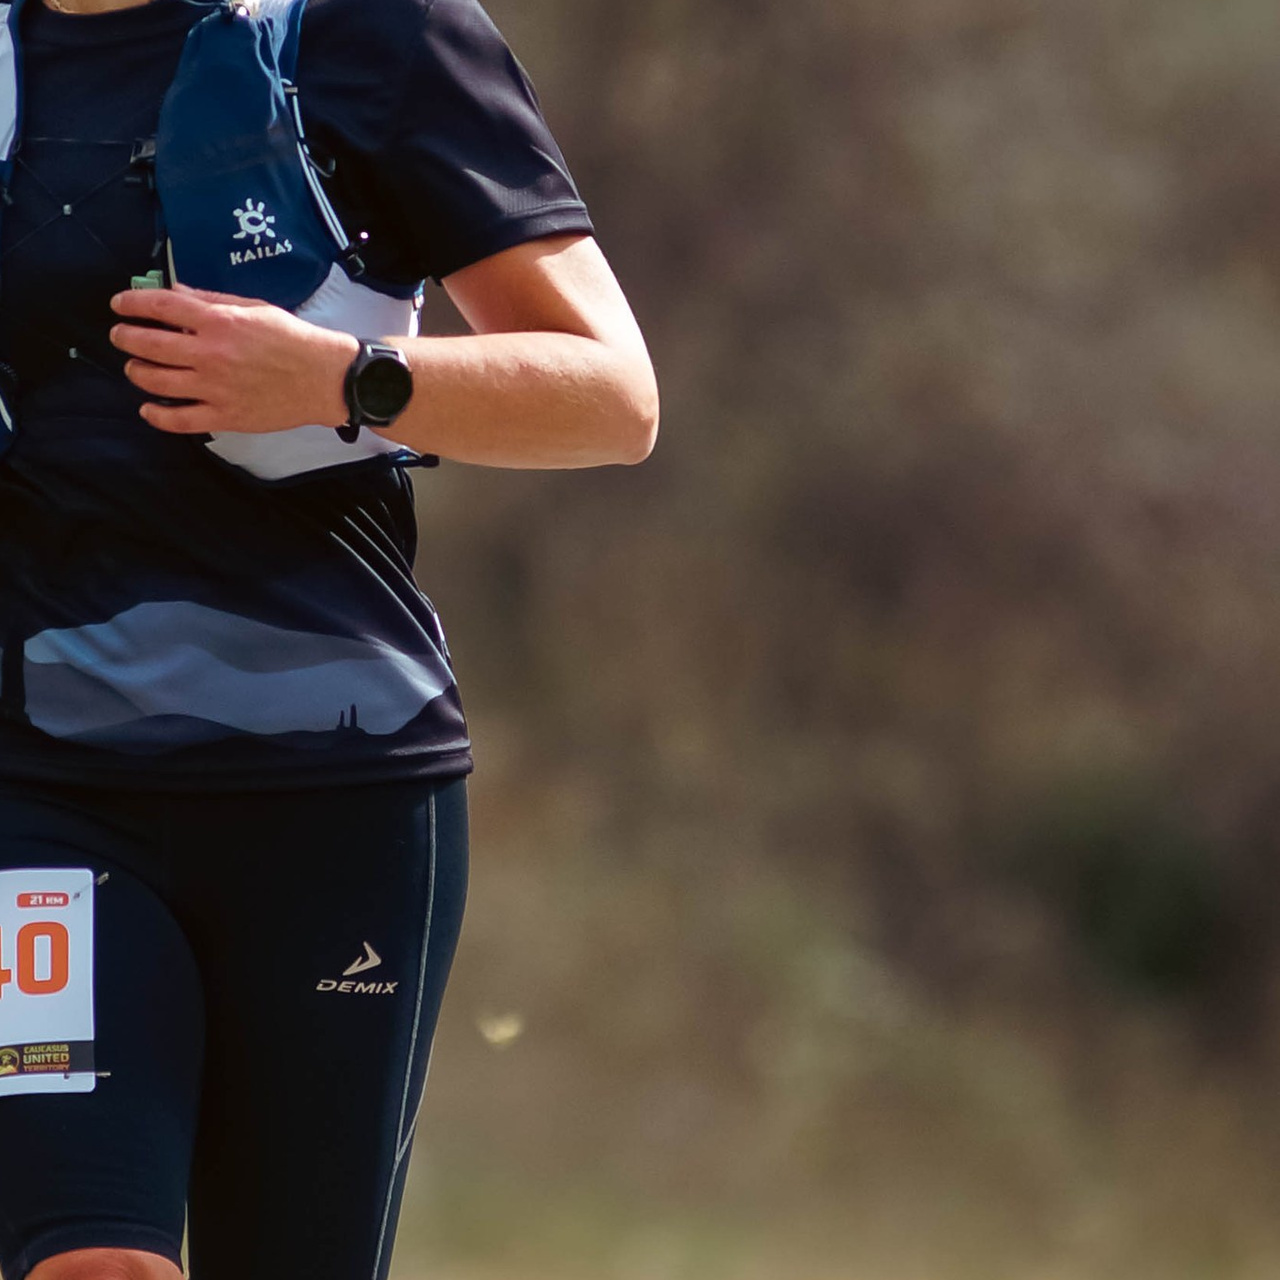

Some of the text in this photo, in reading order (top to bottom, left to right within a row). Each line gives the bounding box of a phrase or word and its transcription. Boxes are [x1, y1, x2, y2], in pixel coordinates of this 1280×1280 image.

[230, 239, 293, 266] KAILAS
[30, 894, 43, 906] 21
[315, 979, 399, 994] DEMIX
[23, 1044, 69, 1054] CAUCASUS
[23, 1052, 70, 1064] UNITED
